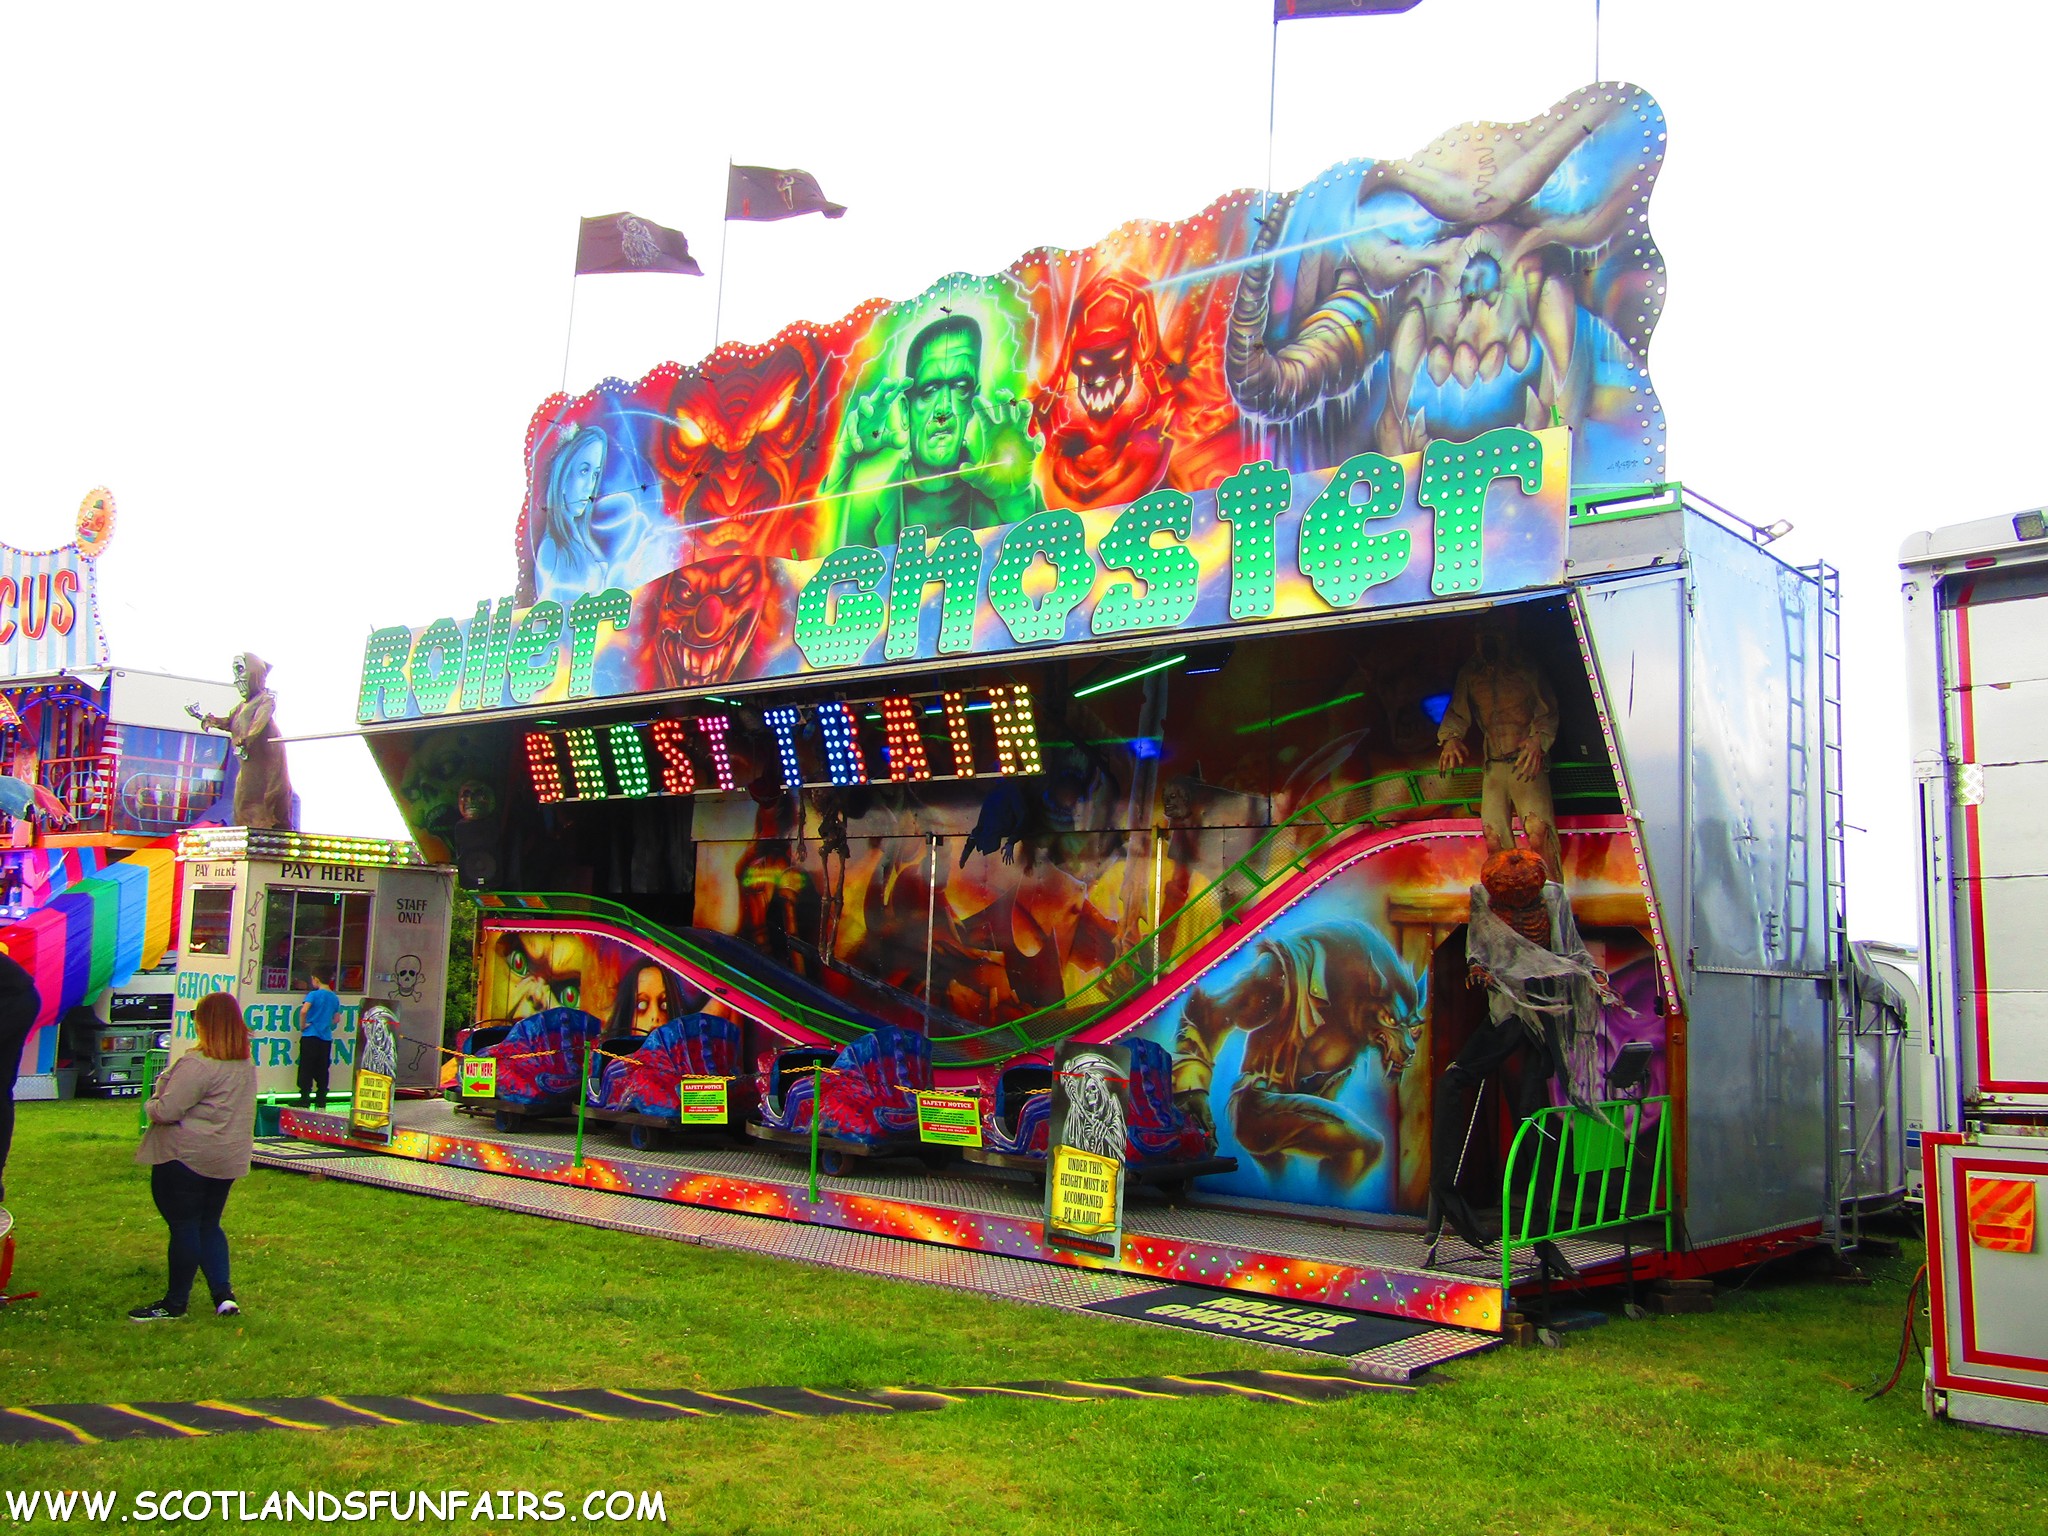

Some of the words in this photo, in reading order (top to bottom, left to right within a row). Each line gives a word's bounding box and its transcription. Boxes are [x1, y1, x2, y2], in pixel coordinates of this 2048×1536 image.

[525, 714, 735, 803] GHOST
[762, 683, 1045, 788] TRAIN
[195, 864, 210, 877] PAY
[214, 865, 237, 877] HERE
[281, 863, 314, 879] PAY
[321, 866, 366, 882] HERE
[396, 898, 428, 911] STAFF
[398, 911, 424, 924] ONLY
[243, 1004, 360, 1033] GHT
[250, 1036, 357, 1067] TRN
[465, 1062, 479, 1077] WAIT
[481, 1062, 493, 1077] HERE
[111, 1087, 143, 1096] ERF
[1067, 1157, 1088, 1173] UNDER
[1088, 1160, 1103, 1175] THIS
[1060, 1172, 1082, 1189] HEIGHT
[1083, 1177, 1100, 1192] MUST
[1100, 1179, 1109, 1193] BE
[1062, 1190, 1104, 1209] ACCOMPANIED
[1063, 1207, 1072, 1222] BY
[1073, 1208, 1081, 1221] AN
[1081, 1211, 1101, 1224] ADULT
[1197, 1297, 1357, 1328] ROLLER
[1145, 1304, 1335, 1341] GHOSTER
